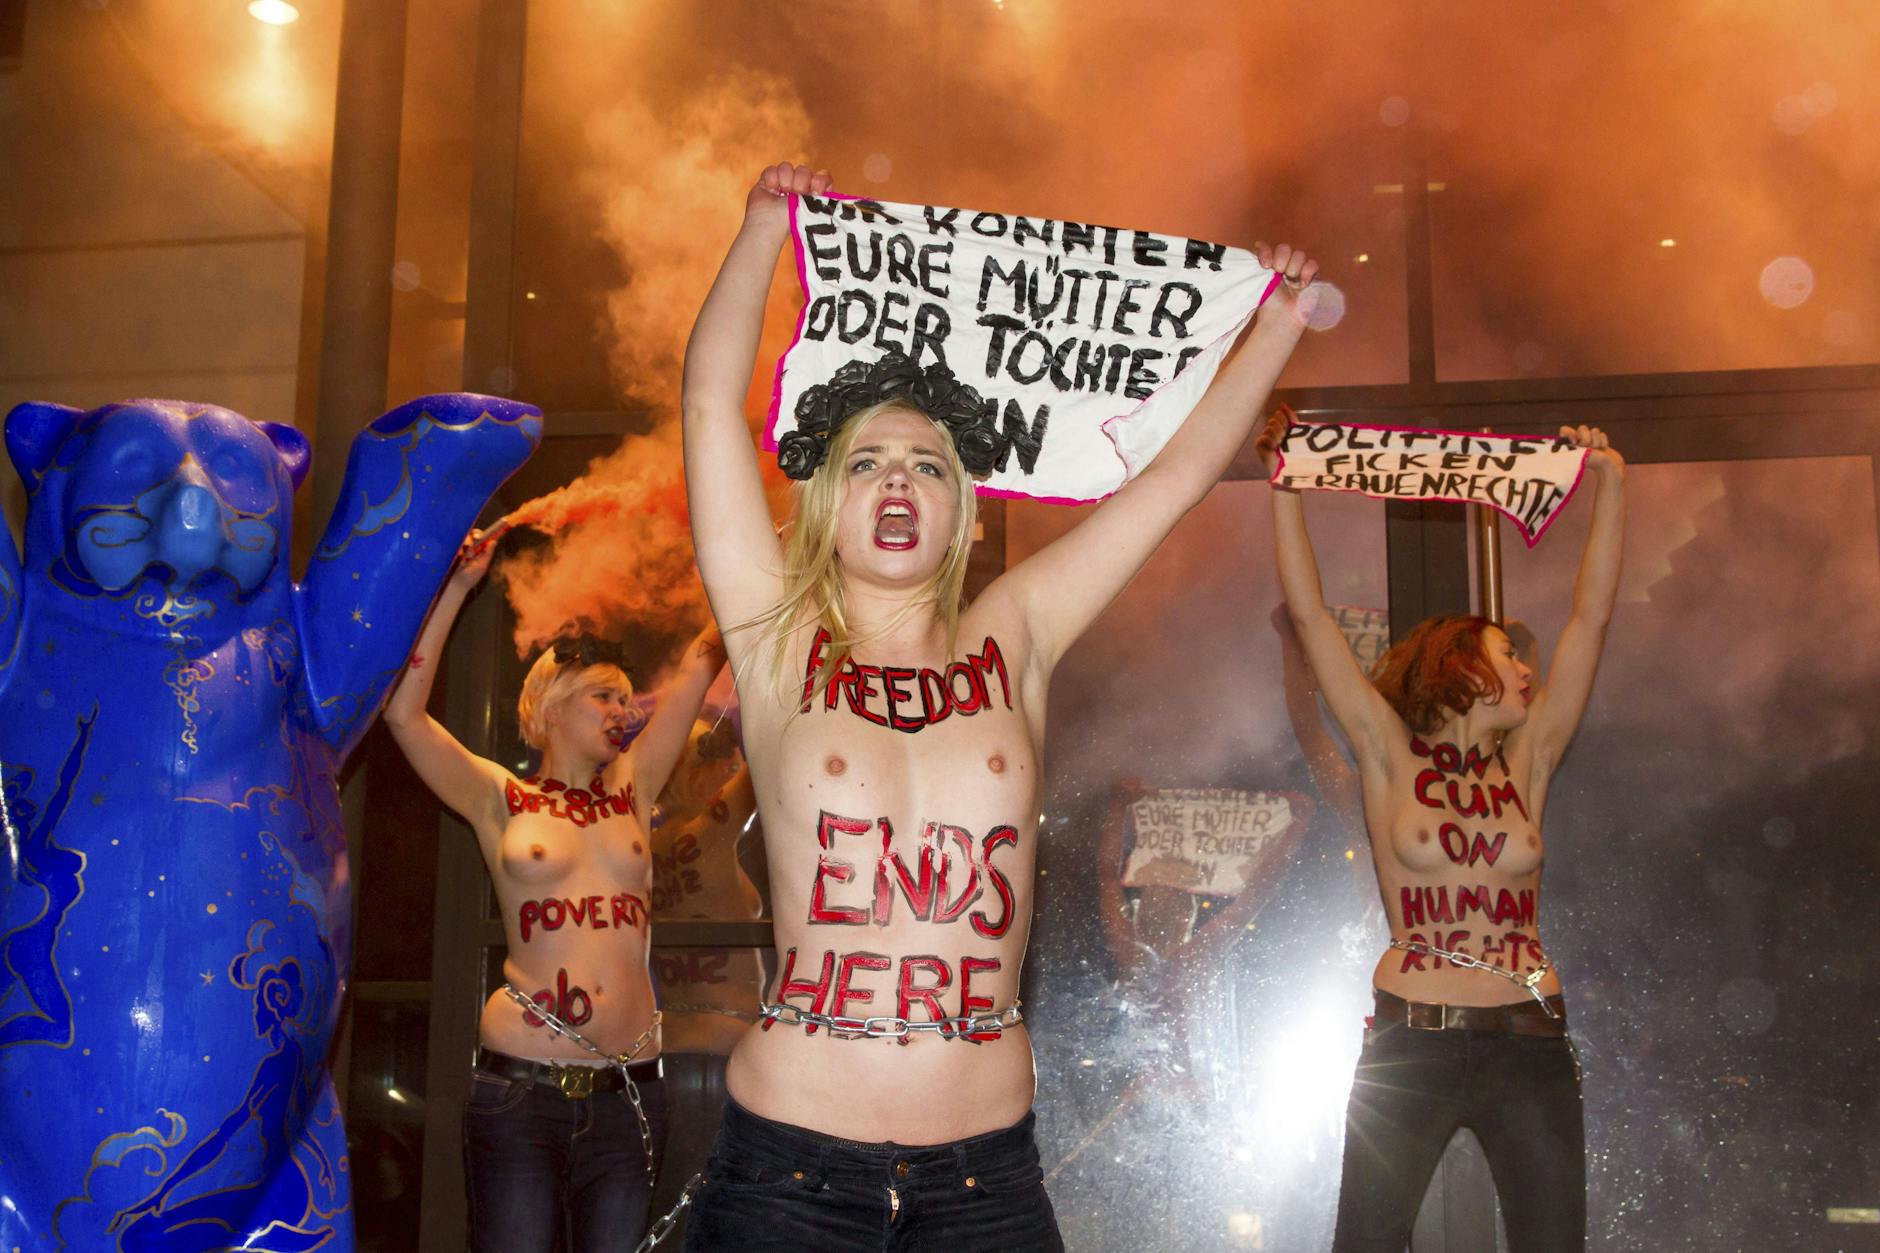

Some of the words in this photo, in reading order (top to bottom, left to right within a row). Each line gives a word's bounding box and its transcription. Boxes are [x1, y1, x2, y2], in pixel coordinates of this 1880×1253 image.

[805, 222, 954, 299] EURE
[976, 254, 1204, 339] MÜTTER
[804, 288, 951, 368] ODER
[1326, 451, 1517, 474] FICKEN
[801, 625, 1013, 734] FREEDOM
[1414, 768, 1529, 822] CUM
[808, 809, 1018, 940] ENDS
[1439, 822, 1508, 868] ON
[1401, 885, 1535, 929] HUMAN
[761, 947, 1002, 1046] HERE
